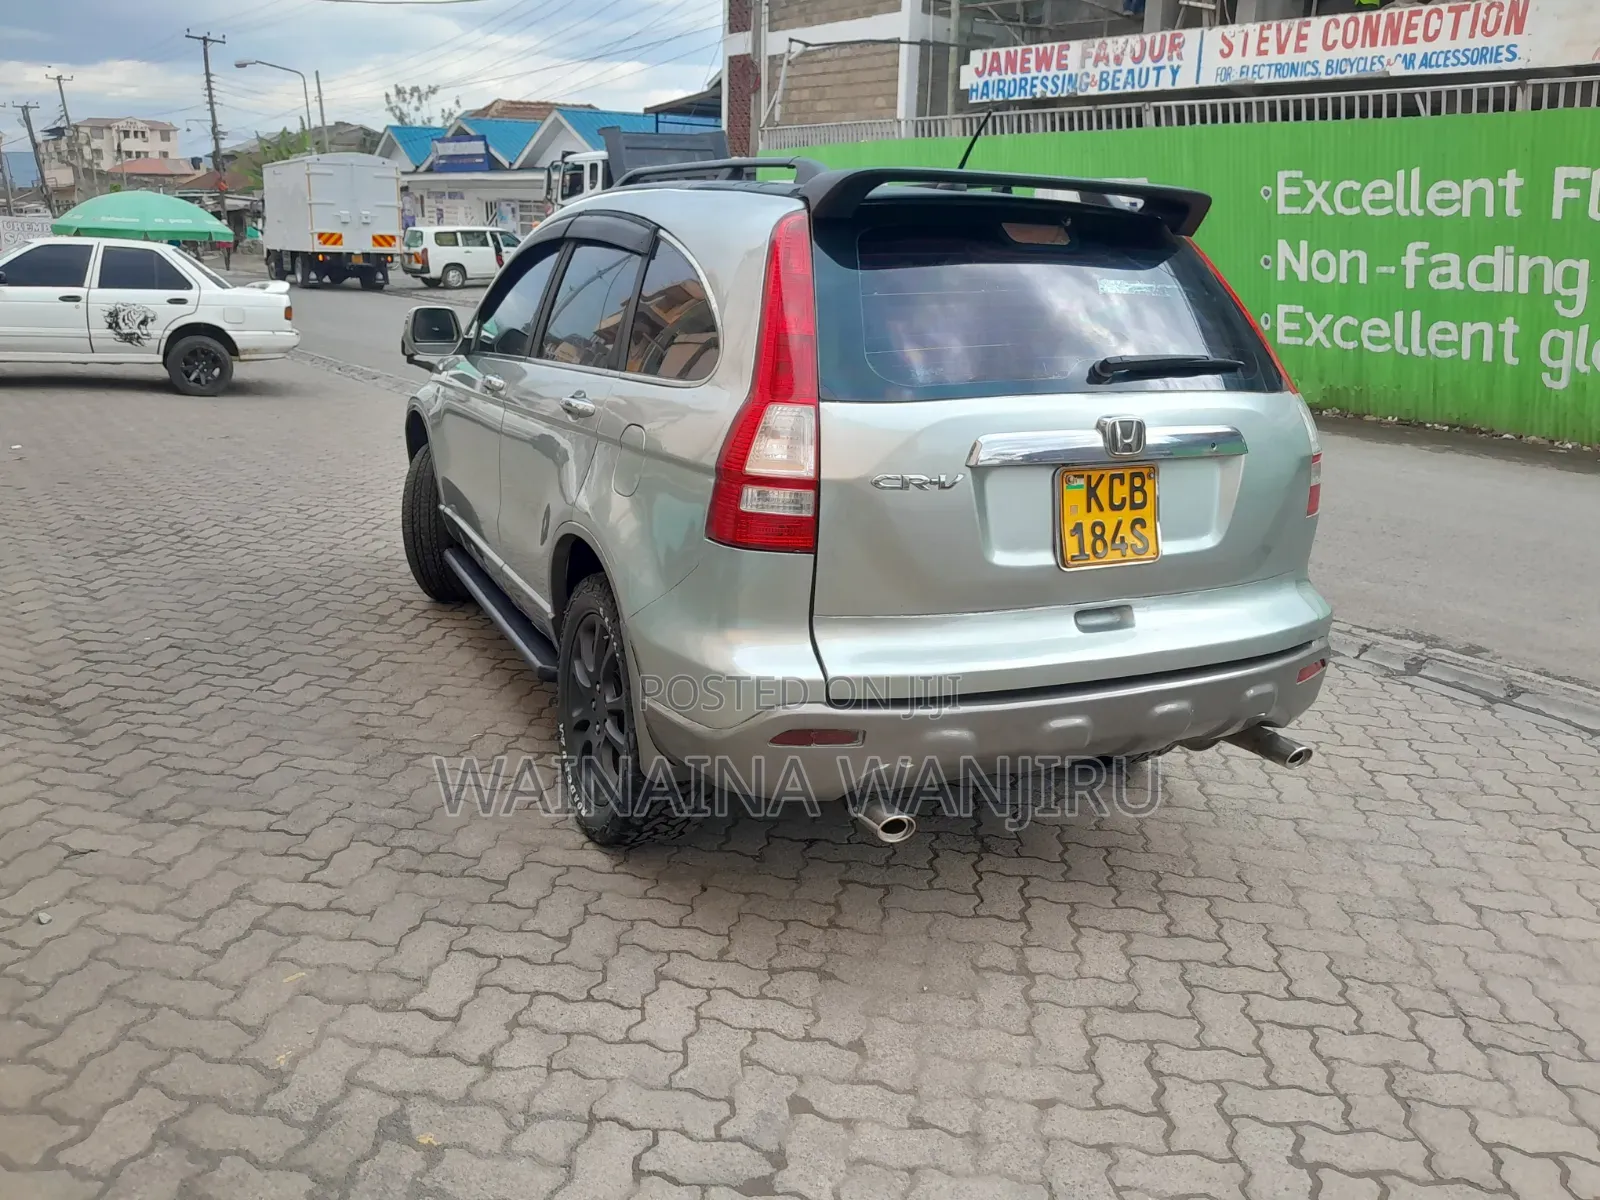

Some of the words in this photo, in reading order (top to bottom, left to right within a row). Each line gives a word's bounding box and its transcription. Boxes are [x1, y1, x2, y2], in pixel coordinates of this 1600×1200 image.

[1219, 20, 1311, 59] STEVE
[1321, 0, 1531, 52] CONNECTION
[974, 43, 1071, 78] JANEWE
[1080, 32, 1186, 69] FAVOUR
[969, 71, 1090, 101] HAIRDRESSING
[1098, 64, 1182, 91] BEAUTY
[1277, 167, 1525, 217] Excellent
[2, 220, 52, 232] UREMB
[1277, 239, 1589, 318] Non-fading
[1277, 304, 1519, 365] Excellent
[870, 474, 965, 490] CR-V
[1086, 471, 1147, 513] KCB
[1070, 517, 1149, 561] 184S
